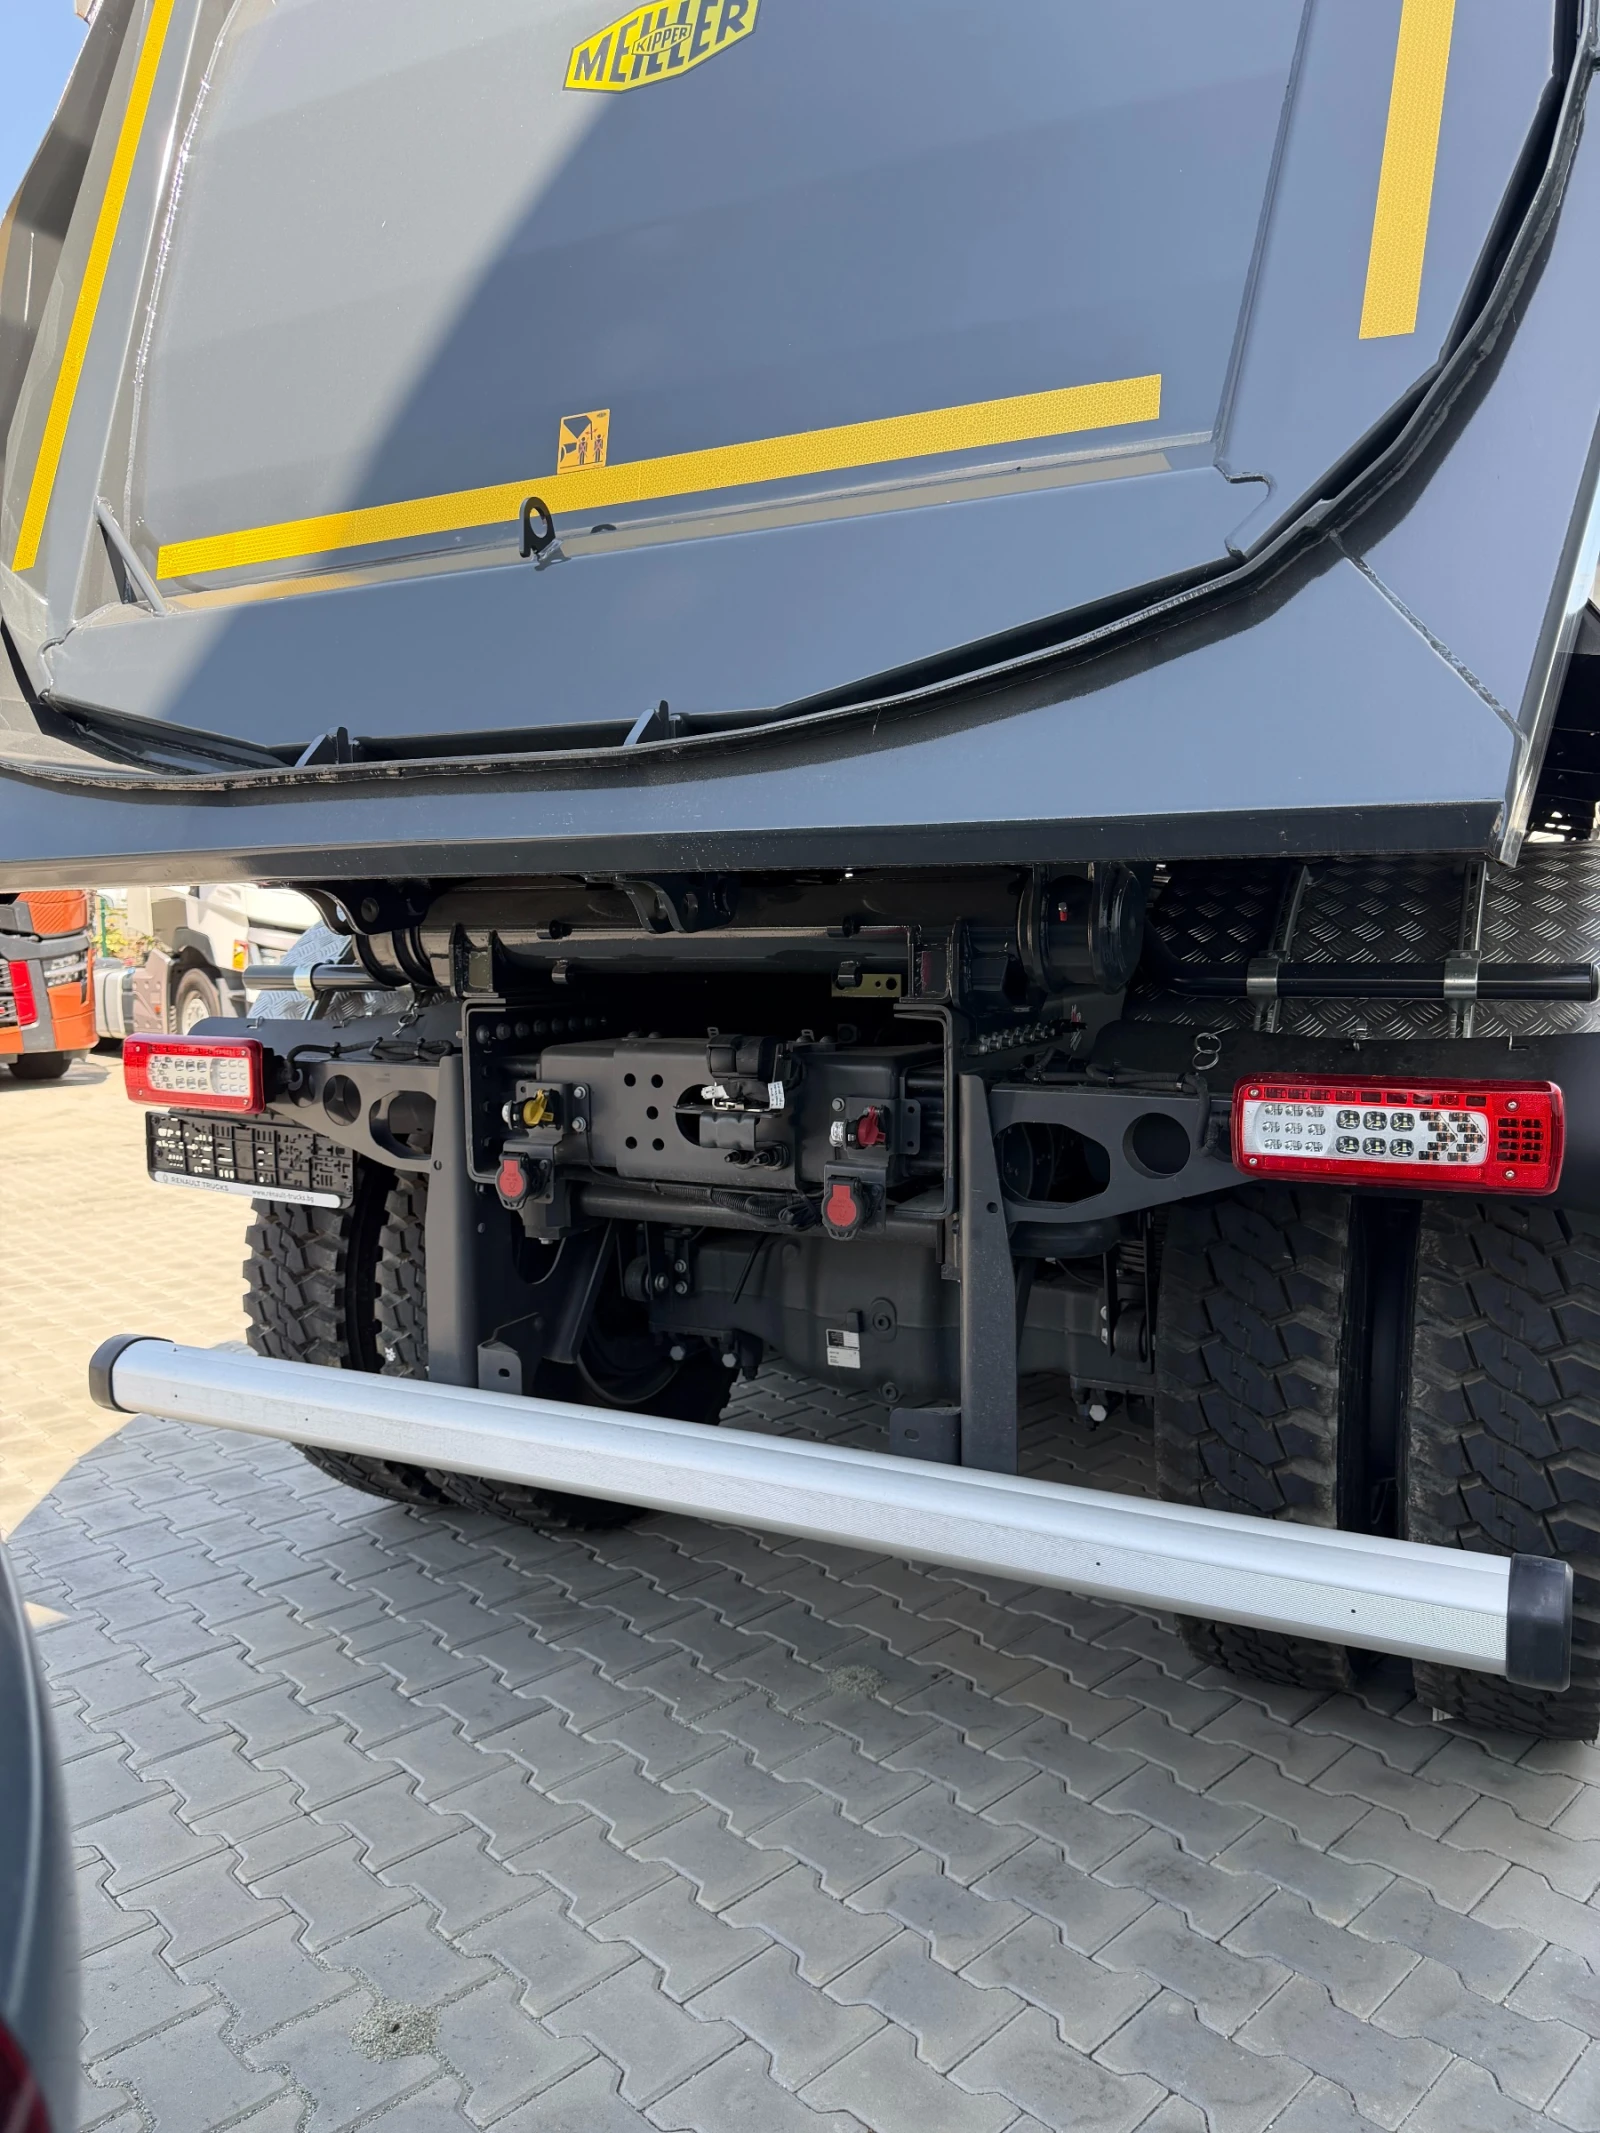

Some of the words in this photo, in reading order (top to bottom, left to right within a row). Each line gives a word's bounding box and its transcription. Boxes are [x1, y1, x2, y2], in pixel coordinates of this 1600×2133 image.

[573, 0, 750, 83] MEILLER
[635, 26, 688, 53] KIPPER
[170, 1176, 201, 1187] RENAULT
[202, 1181, 229, 1192] TRUCKS
[251, 1188, 315, 1203] www.renault-trucks.bg
